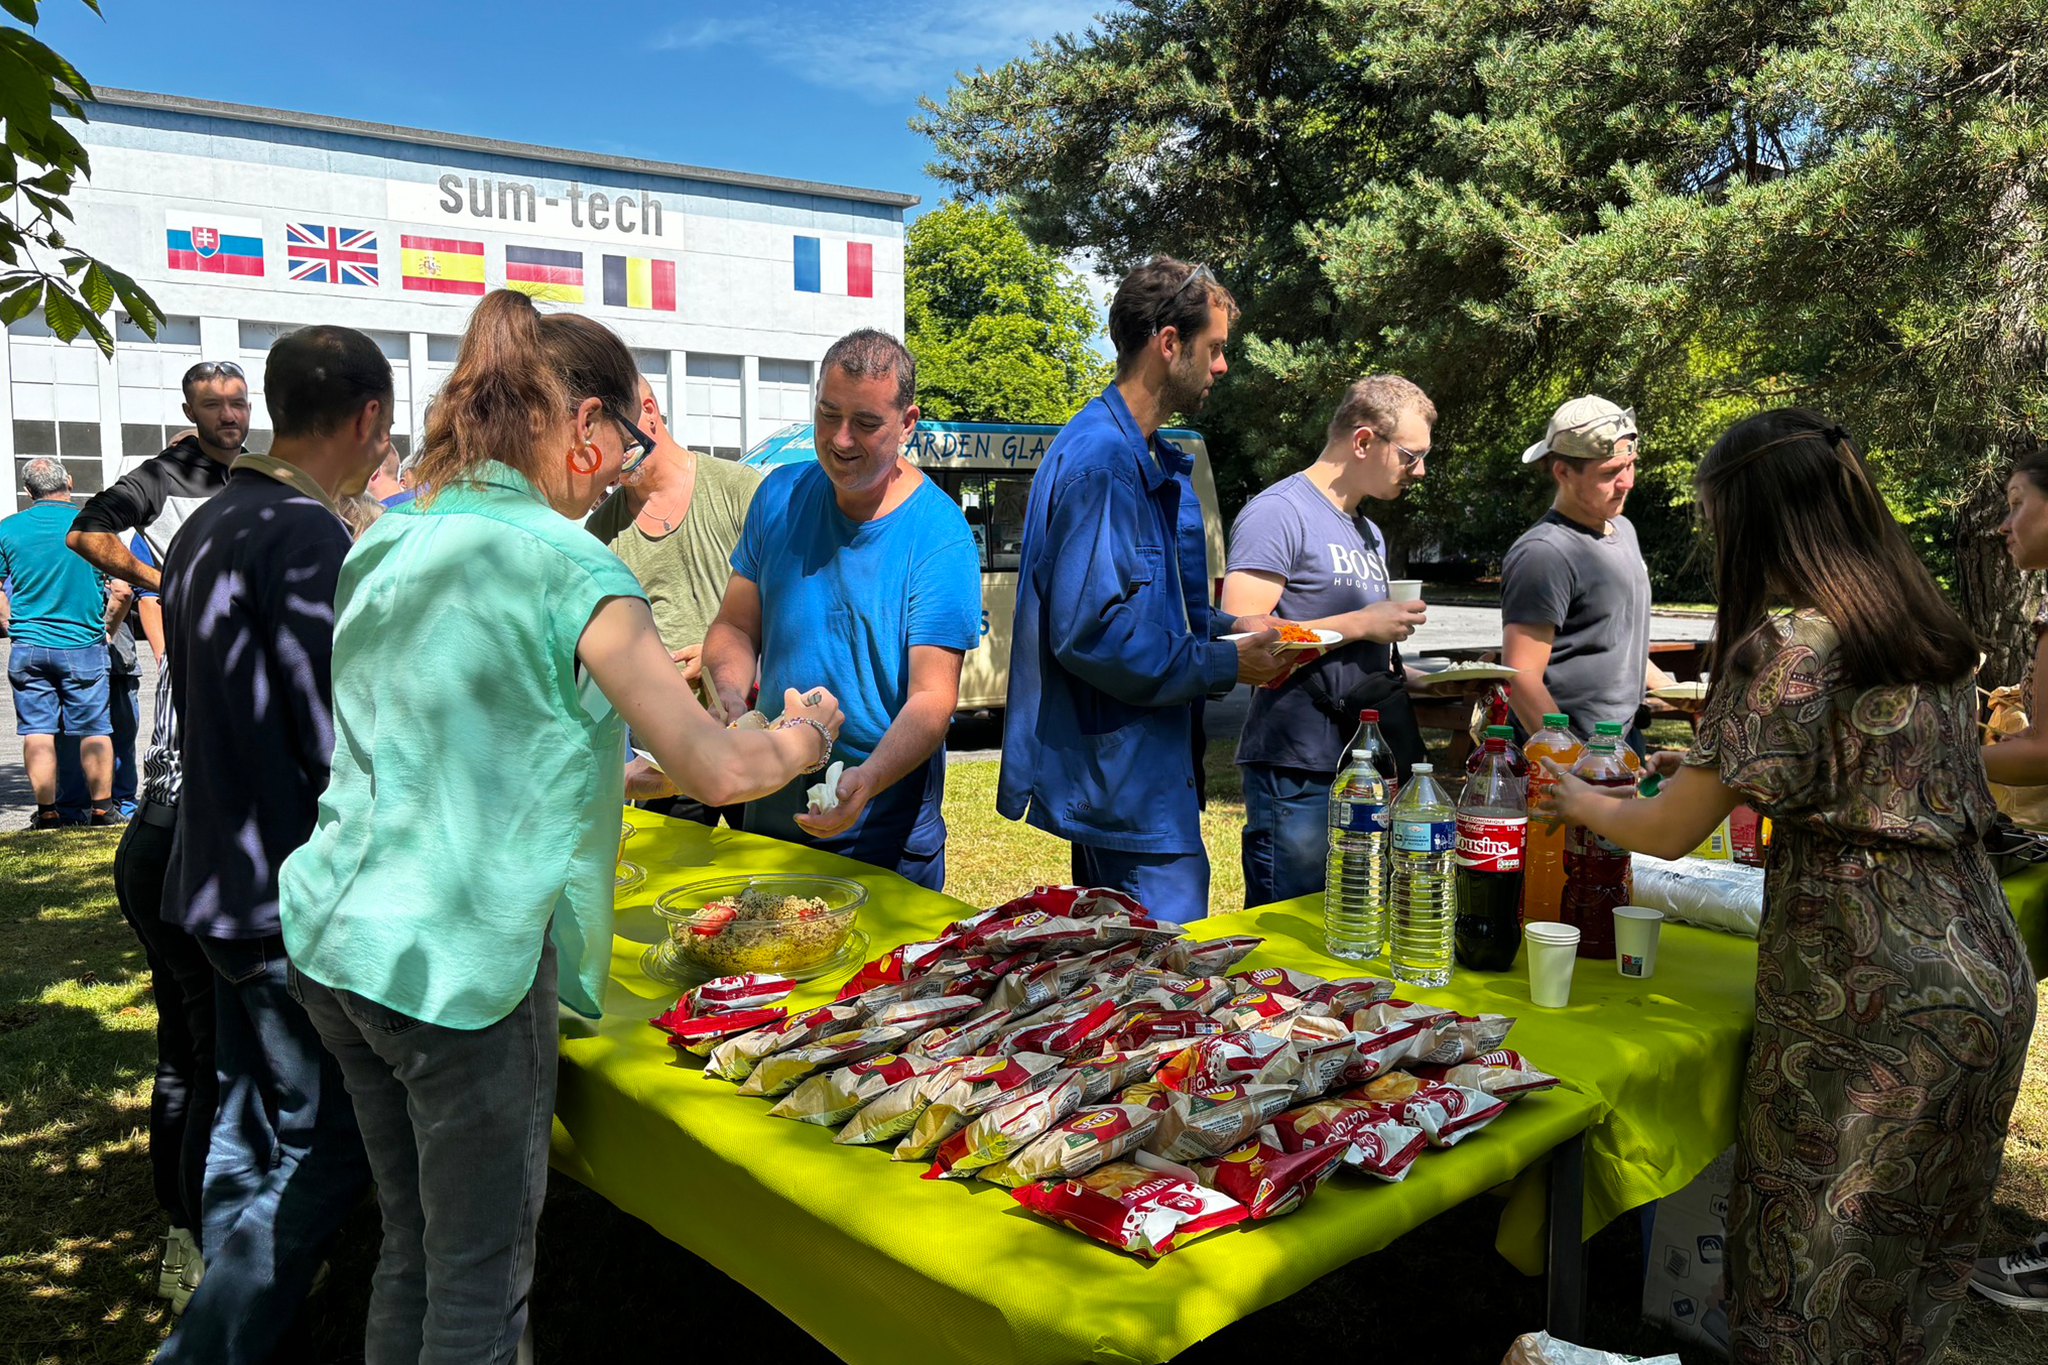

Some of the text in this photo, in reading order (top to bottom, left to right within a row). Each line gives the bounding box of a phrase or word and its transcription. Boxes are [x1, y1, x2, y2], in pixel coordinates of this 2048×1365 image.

[439, 173, 662, 236] sum-tech
[904, 431, 991, 461] ARDEN
[1334, 577, 1368, 590] HUGO
[1123, 1178, 1176, 1201] NATURE
